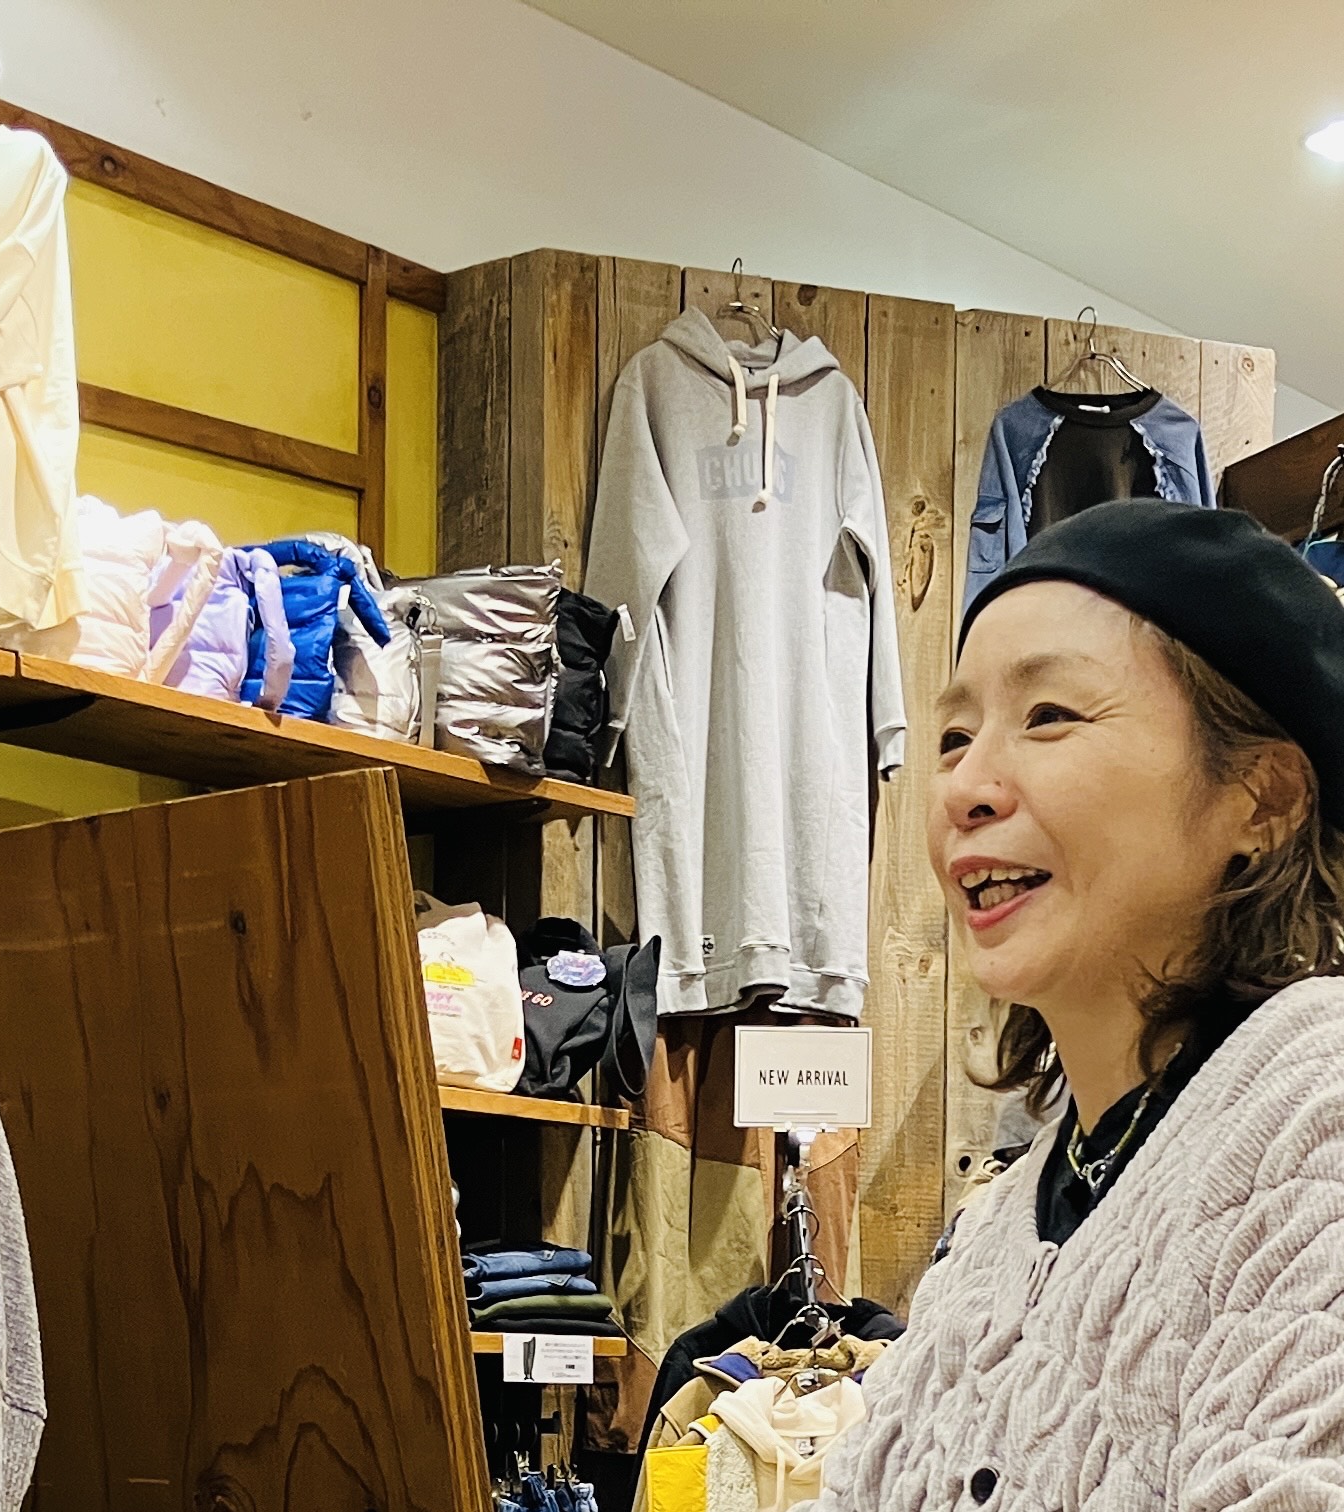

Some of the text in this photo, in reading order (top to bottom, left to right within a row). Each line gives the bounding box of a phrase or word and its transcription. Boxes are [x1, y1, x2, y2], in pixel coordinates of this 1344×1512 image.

[705, 452, 787, 494] CHUS
[759, 1069, 849, 1086] NEW ARRIVAL
